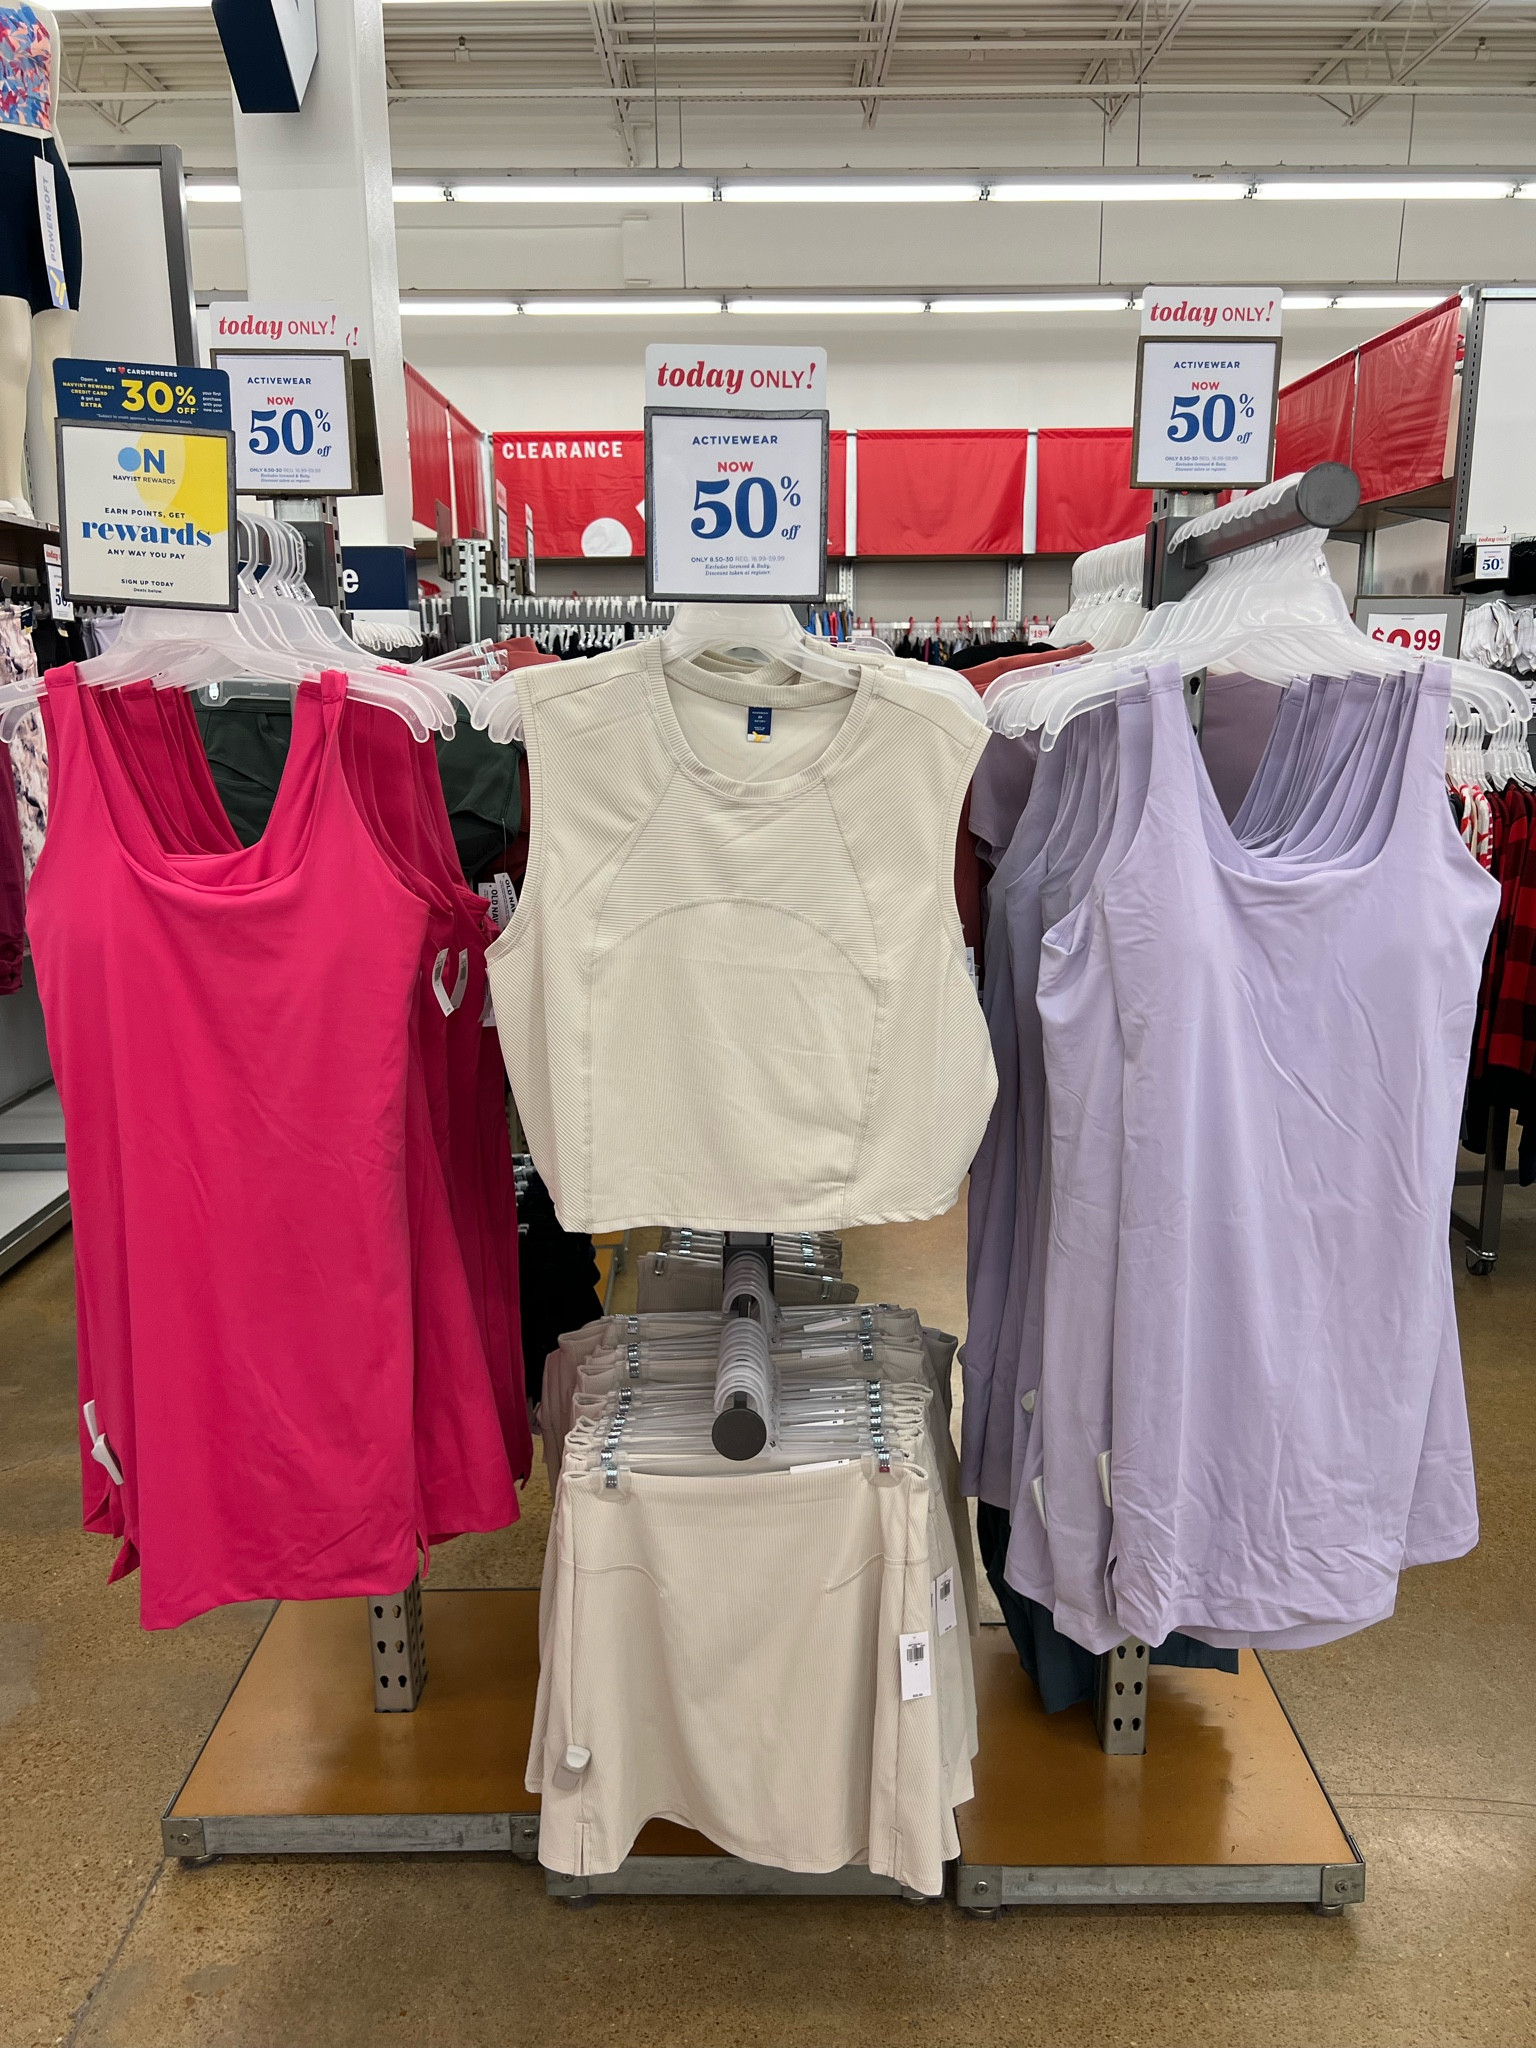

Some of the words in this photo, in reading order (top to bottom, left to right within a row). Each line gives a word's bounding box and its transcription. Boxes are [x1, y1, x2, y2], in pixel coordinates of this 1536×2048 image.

[43, 176, 56, 262] POWERSOFT
[1150, 301, 1218, 327] today
[1222, 301, 1274, 322] ONLY!
[219, 315, 283, 340] today
[288, 315, 336, 335] ONLY!
[126, 368, 178, 378] CARDMEMBERS
[657, 361, 744, 394] today
[750, 362, 816, 389] ONLY!
[1191, 382, 1220, 390] NOW
[267, 397, 294, 405] NOW
[692, 436, 778, 445] ACTIVEWEAR
[1237, 432, 1252, 444] off
[317, 446, 332, 457] off
[502, 441, 623, 459] CLEARANCE
[718, 462, 754, 472] NOW
[132, 510, 166, 518] POINTS,
[82, 521, 212, 548] rewards
[781, 525, 801, 540] off
